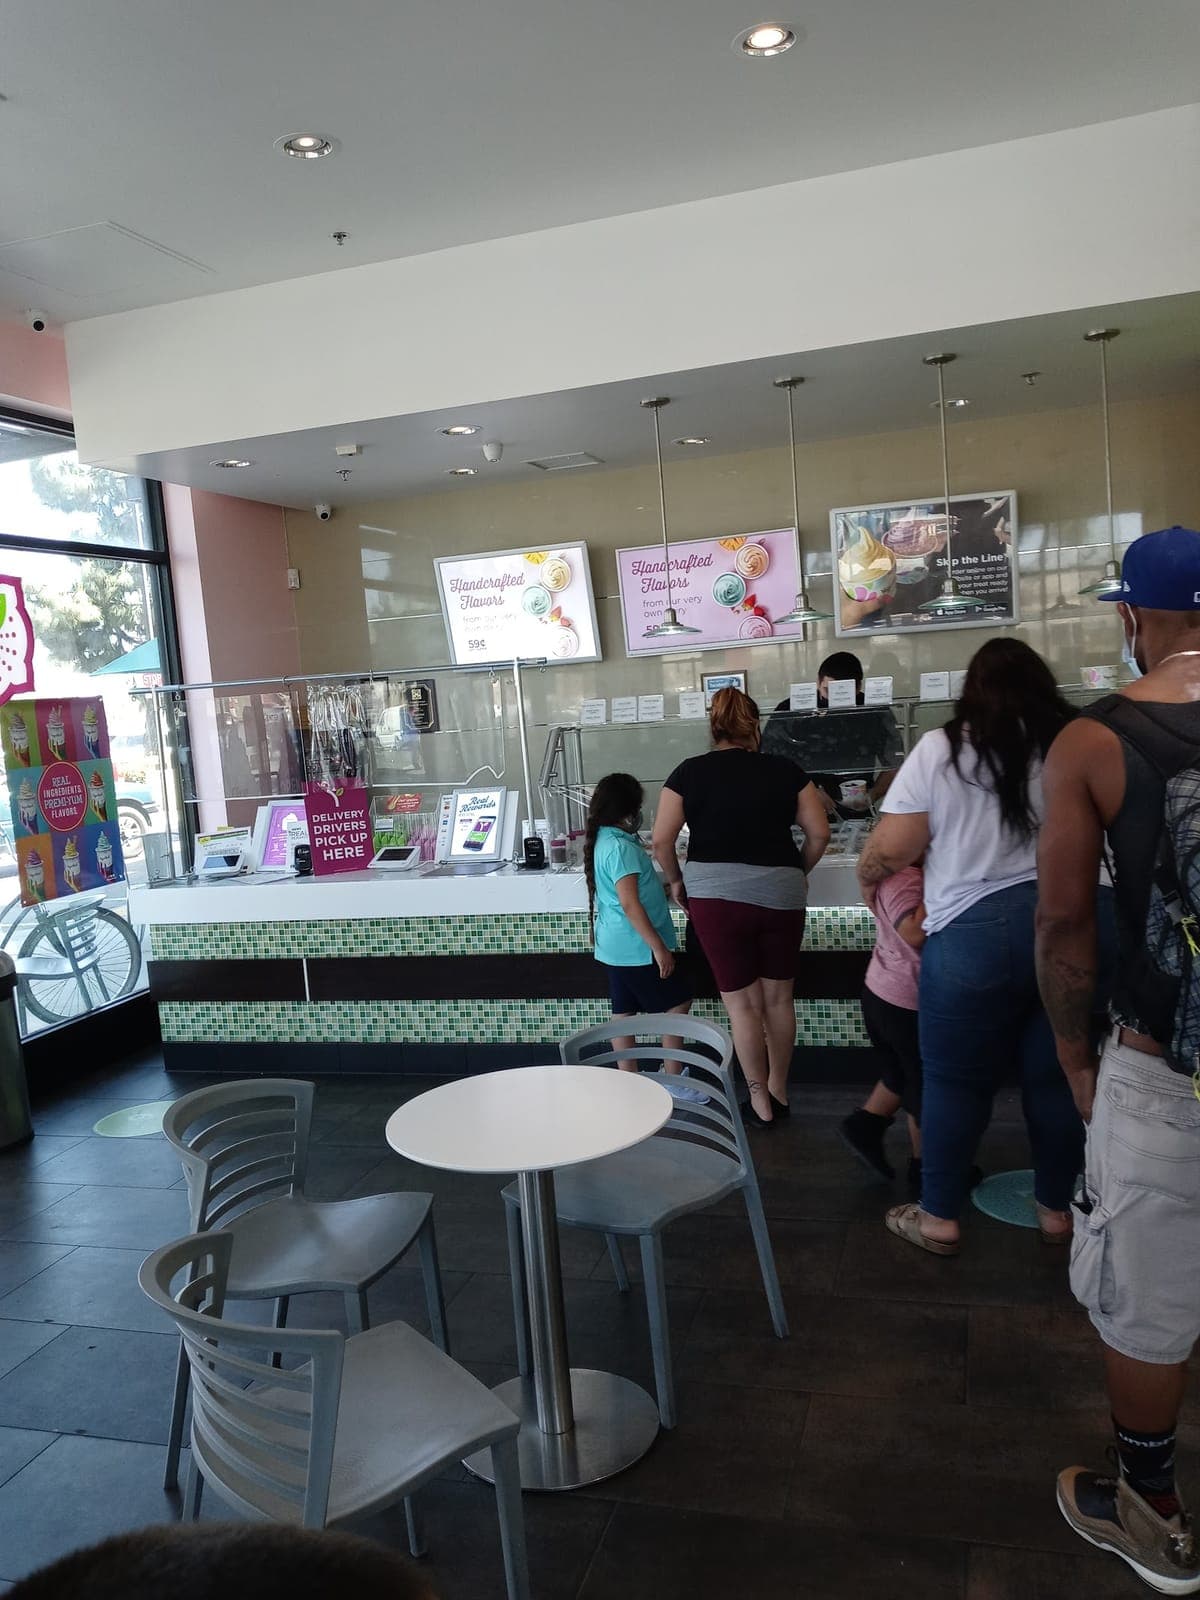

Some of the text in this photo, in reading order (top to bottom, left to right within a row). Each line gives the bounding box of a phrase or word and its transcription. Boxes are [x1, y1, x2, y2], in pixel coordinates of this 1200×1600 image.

[631, 553, 714, 576] Handcrafted
[961, 556, 979, 565] the
[449, 572, 526, 594] Handcrafted
[460, 595, 505, 610] Flavors
[643, 599, 664, 608] from
[682, 595, 703, 605] very
[643, 610, 663, 618] own
[468, 639, 486, 649] 59¢
[52, 776, 71, 787] REAL
[43, 784, 82, 798] INGREDIENTS
[51, 806, 78, 818] FLAVORS
[312, 809, 364, 823] DELIVERY
[313, 820, 367, 835] DRIVERS
[315, 832, 368, 848] PICK UP
[323, 845, 365, 861] HERE
[1118, 1431, 1176, 1448] umbr
